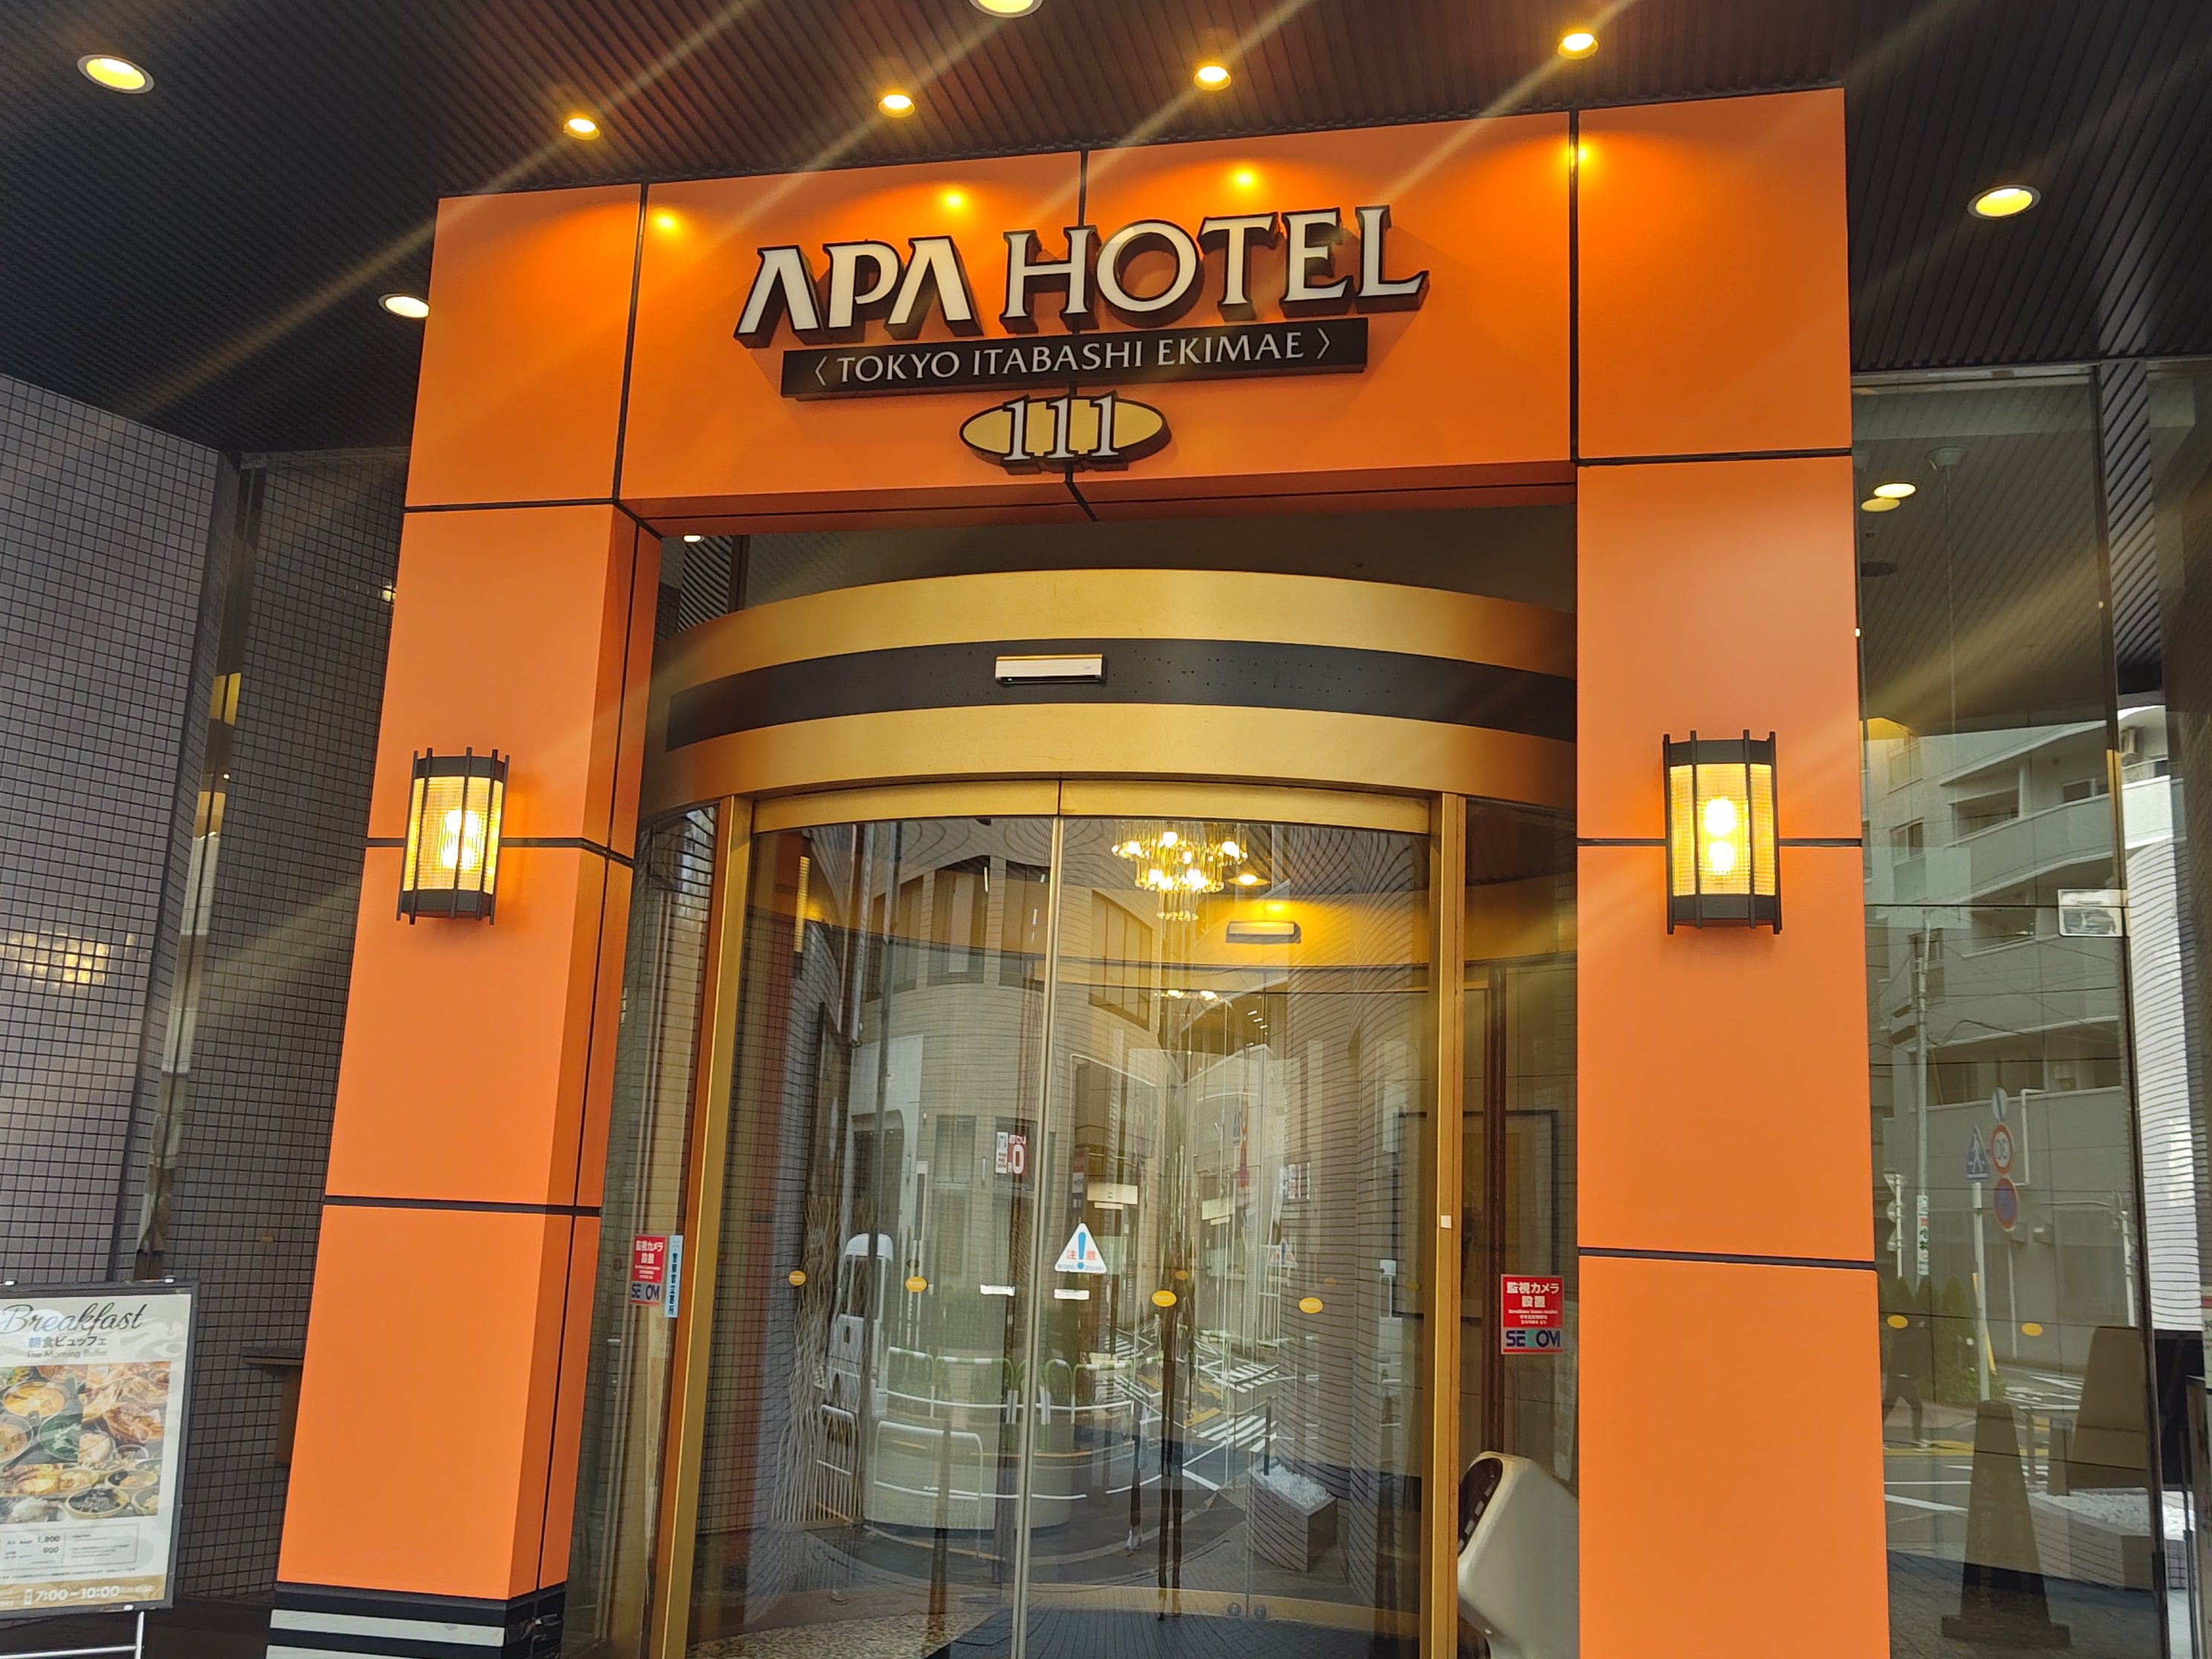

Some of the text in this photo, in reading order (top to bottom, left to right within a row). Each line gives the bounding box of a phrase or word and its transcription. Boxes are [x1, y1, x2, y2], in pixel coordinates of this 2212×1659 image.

[734, 205, 1429, 336] APA HOTEL
[972, 340, 1142, 375] ITABASHI
[1506, 1281, 1560, 1295] 監視カメラ
[1521, 1295, 1546, 1308] 設置
[0, 1301, 148, 1336] Breakfast
[28, 1336, 108, 1349] 朝食ビュッフェ
[1506, 1329, 1561, 1348] SECOM
